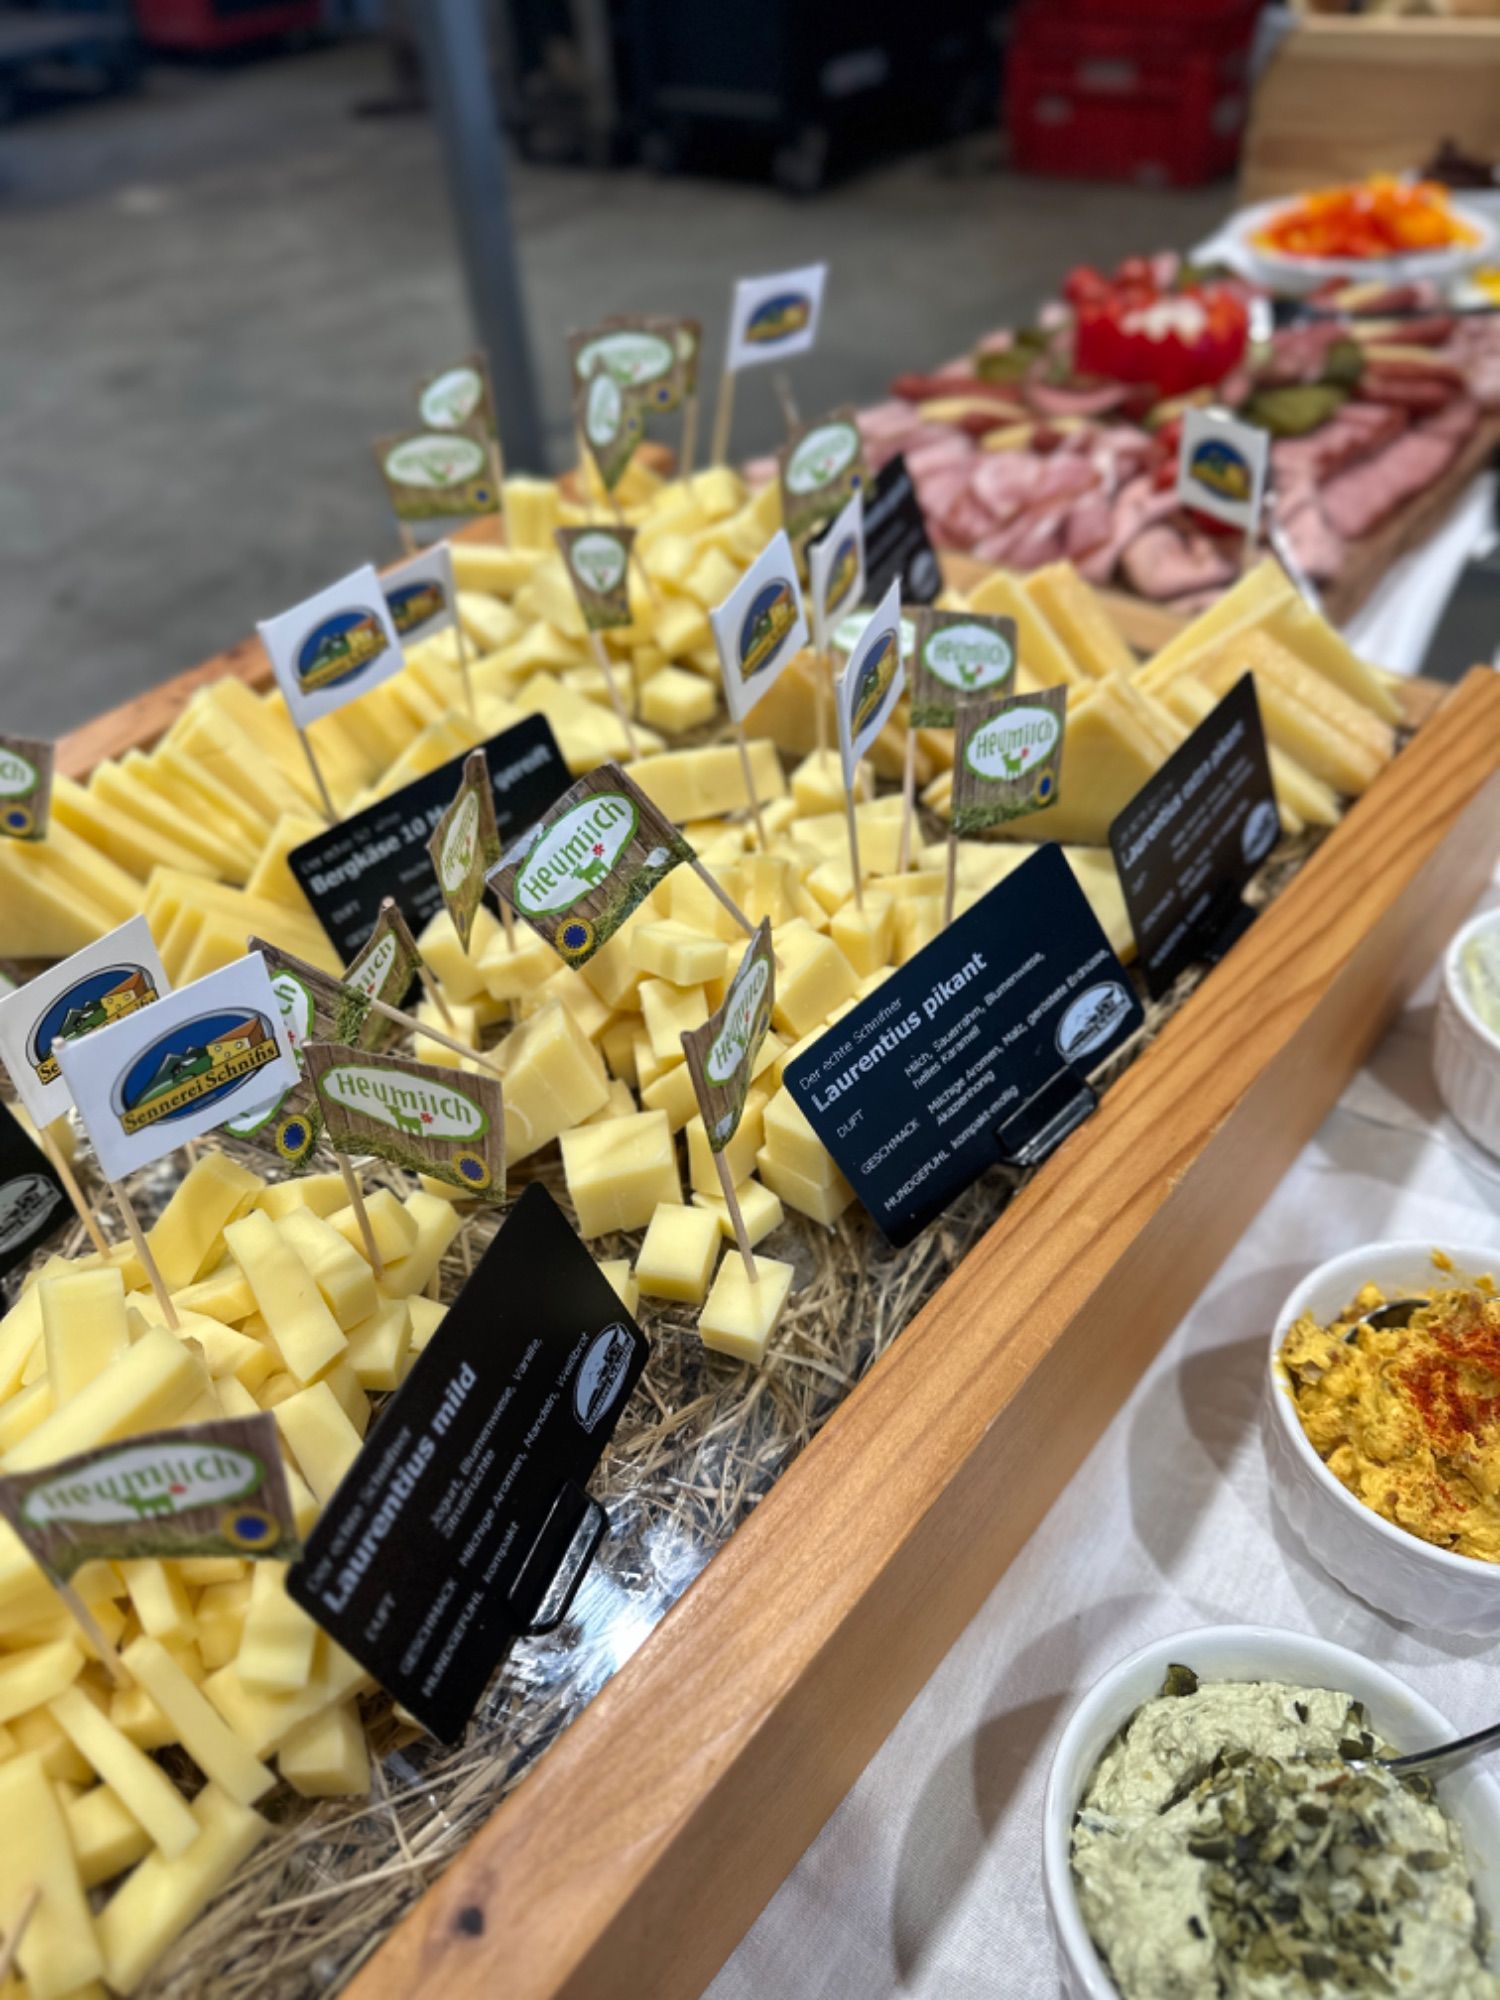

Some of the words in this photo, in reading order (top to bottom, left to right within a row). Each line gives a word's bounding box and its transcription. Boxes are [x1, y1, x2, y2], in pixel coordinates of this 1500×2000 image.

[975, 717, 1054, 760] Heumilch
[522, 801, 626, 902] Heumilch
[811, 1011, 922, 1113] Laurentius
[922, 953, 987, 1020] pikant
[124, 1079, 203, 1129] Sennerei
[204, 1045, 276, 1089] Schnifis
[336, 1072, 472, 1125] Heumilch
[799, 1068, 821, 1091] Der
[836, 1108, 864, 1139] DUFT
[861, 1119, 920, 1175] GESCHMACK
[323, 1435, 436, 1613] Laurentius
[431, 1362, 477, 1435] mild
